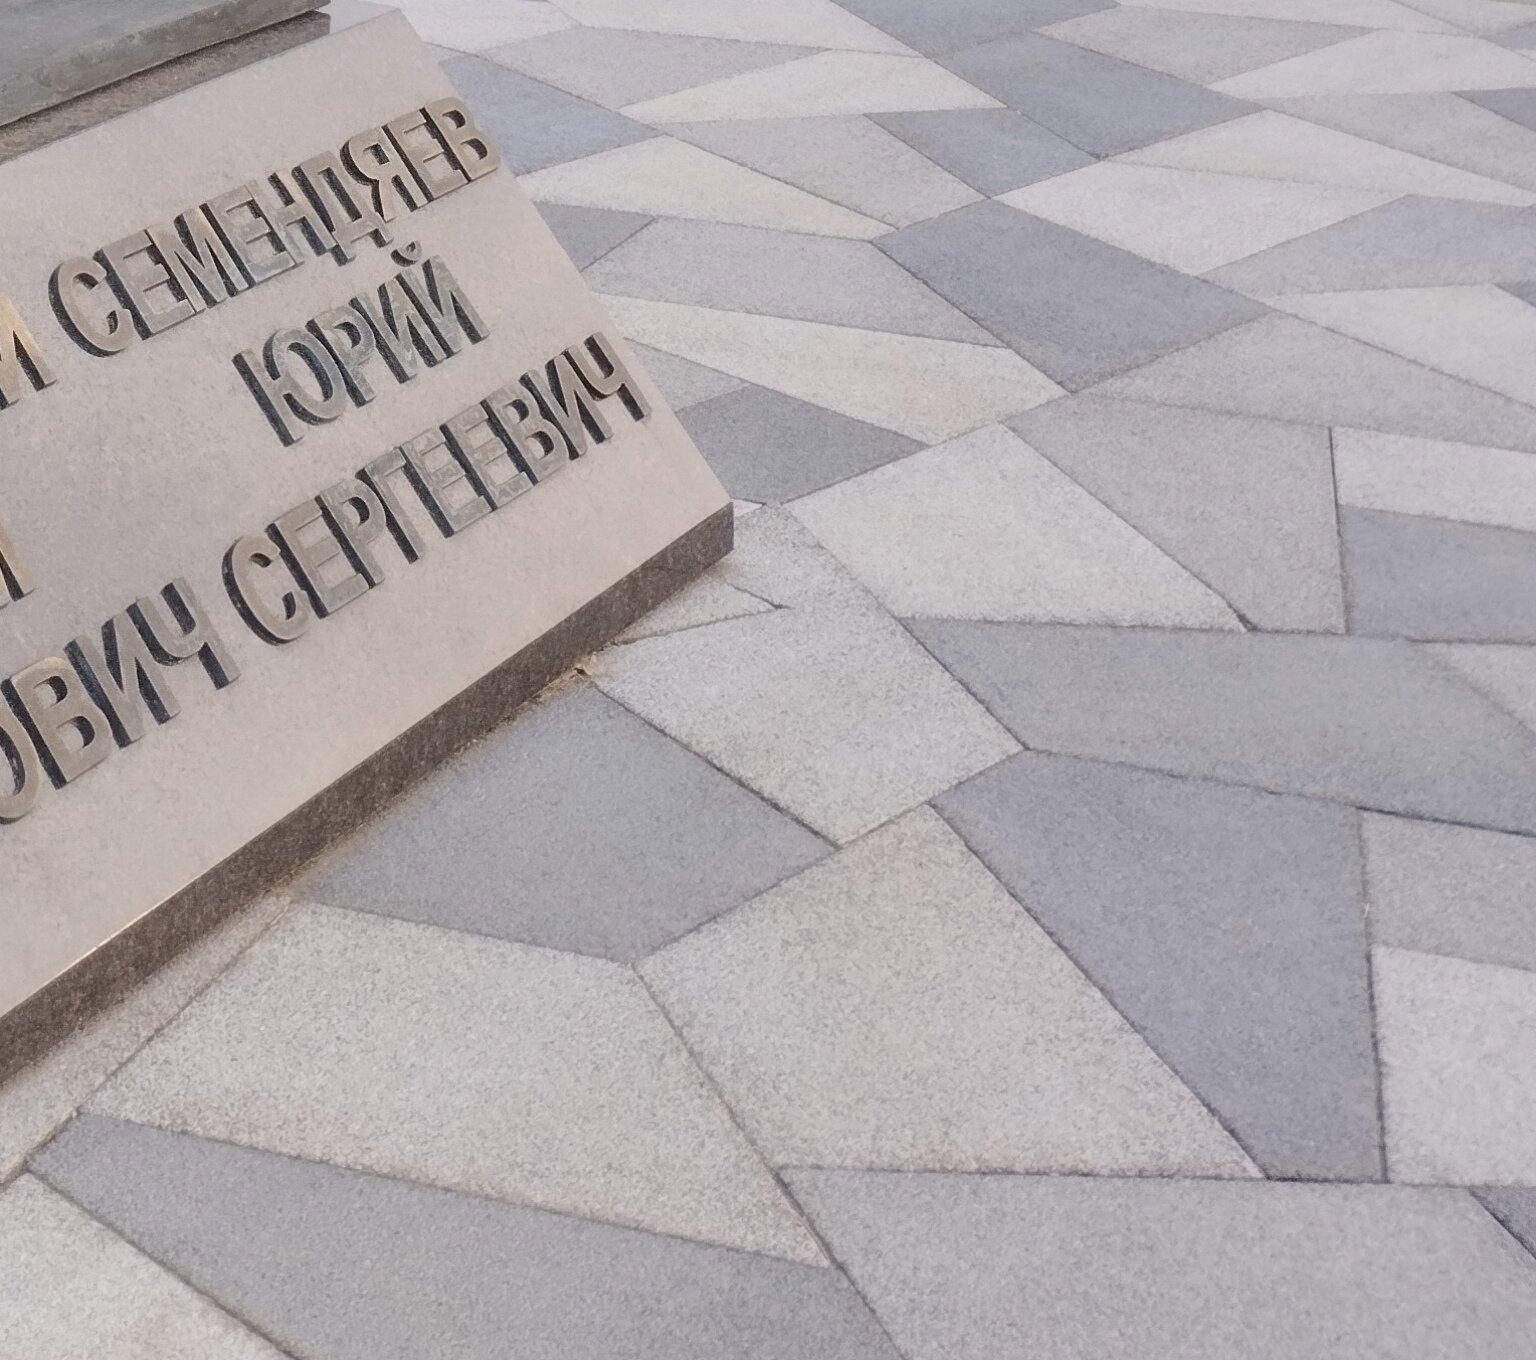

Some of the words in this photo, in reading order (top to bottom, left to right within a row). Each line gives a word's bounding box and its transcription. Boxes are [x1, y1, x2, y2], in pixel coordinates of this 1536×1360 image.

[48, 96, 500, 358] СЕМЕНДЯЕВ
[231, 240, 490, 447] ЮРИЙ
[221, 332, 652, 645] СЕРГЕЕВИЧ
